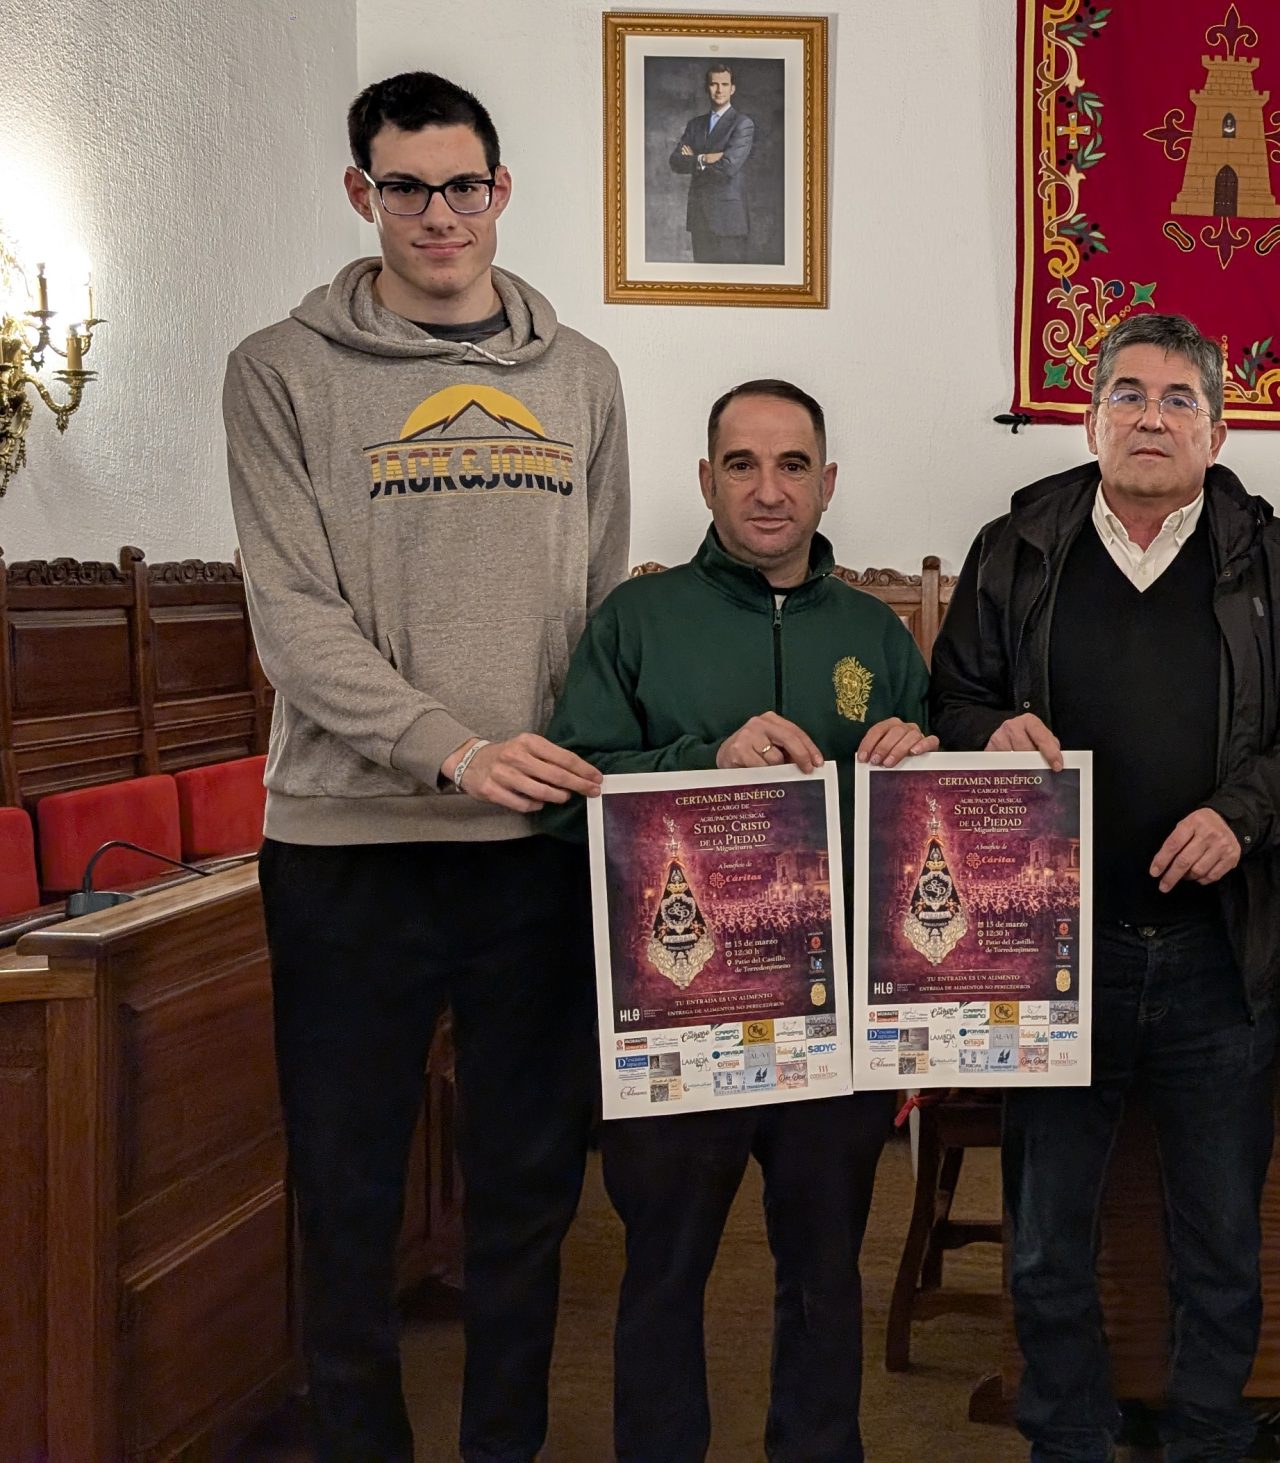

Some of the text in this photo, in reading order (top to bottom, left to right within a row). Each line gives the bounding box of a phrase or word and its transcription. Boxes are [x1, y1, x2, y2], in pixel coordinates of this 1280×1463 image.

[938, 774, 1042, 785] CERTAMEN BENÉFICO
[675, 789, 785, 805] CERTAMEN BENÉFICO
[725, 873, 762, 882] Cáritas
